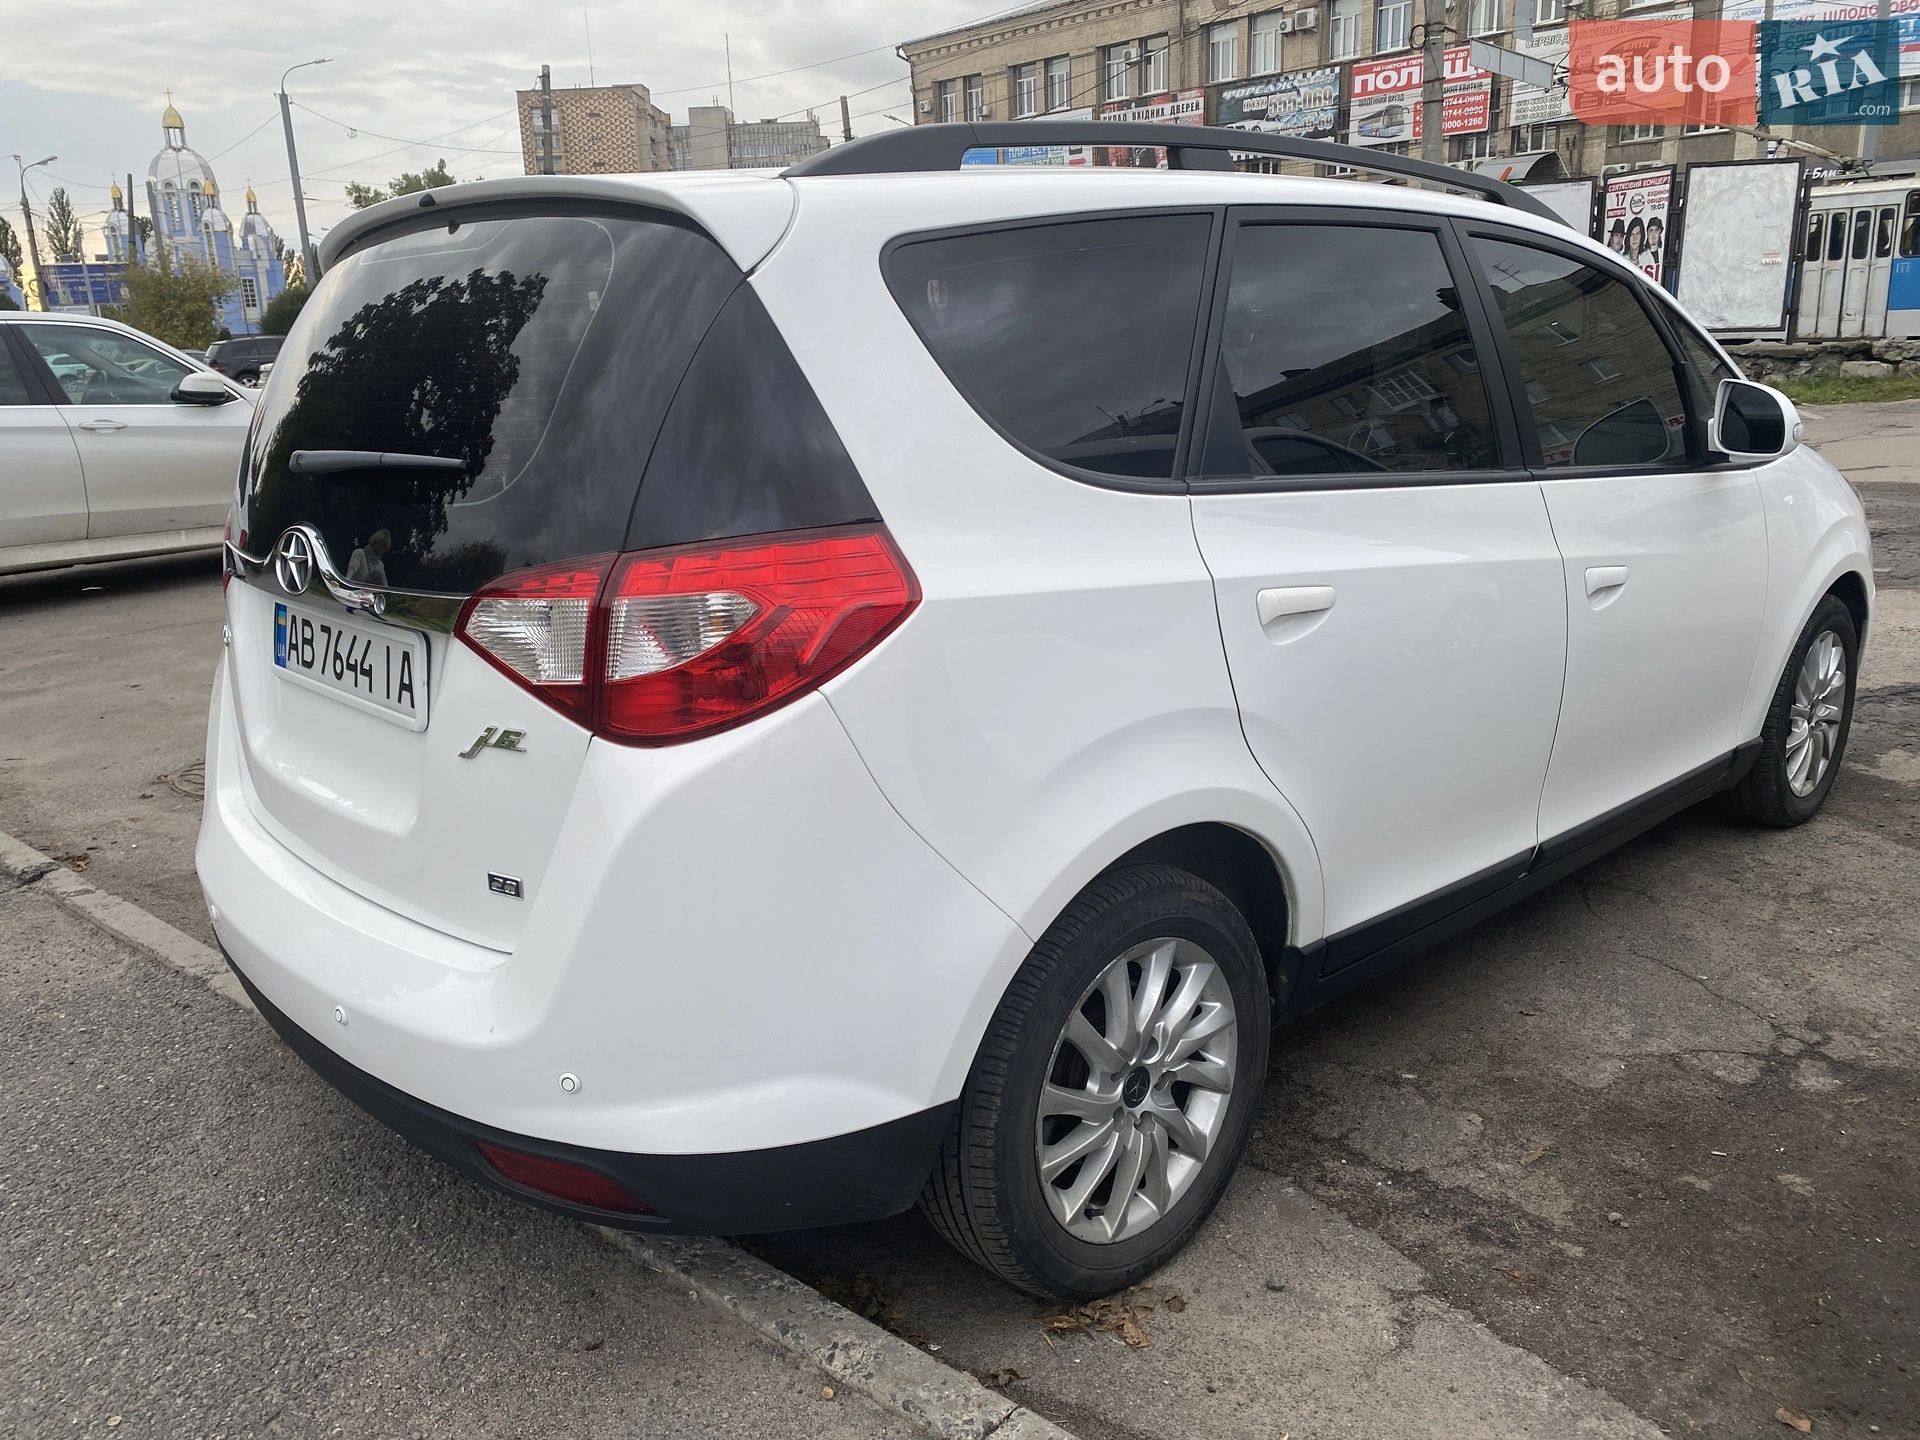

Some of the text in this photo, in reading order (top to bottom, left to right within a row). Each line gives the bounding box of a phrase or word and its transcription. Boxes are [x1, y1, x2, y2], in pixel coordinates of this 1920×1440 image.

[1822, 0, 1920, 23] ЦІЛОДООВО
[1526, 33, 1561, 48] СЕРВІС
[1561, 22, 1626, 44] ДОСТУПНИЙ
[1457, 51, 1467, 59] ДО
[1222, 79, 1295, 100] ФОРСАЖ
[1132, 107, 1165, 121] ВХІДНИХ
[1170, 100, 1200, 116] ДВЕРЕЙ
[1267, 86, 1334, 117] 555-069
[1608, 176, 1670, 192] СВЯТКОВИЙ КОНЦЕРТ
[1615, 192, 1627, 207] 17
[277, 643, 286, 659] UA
[287, 614, 415, 710] AB 7644 IA
